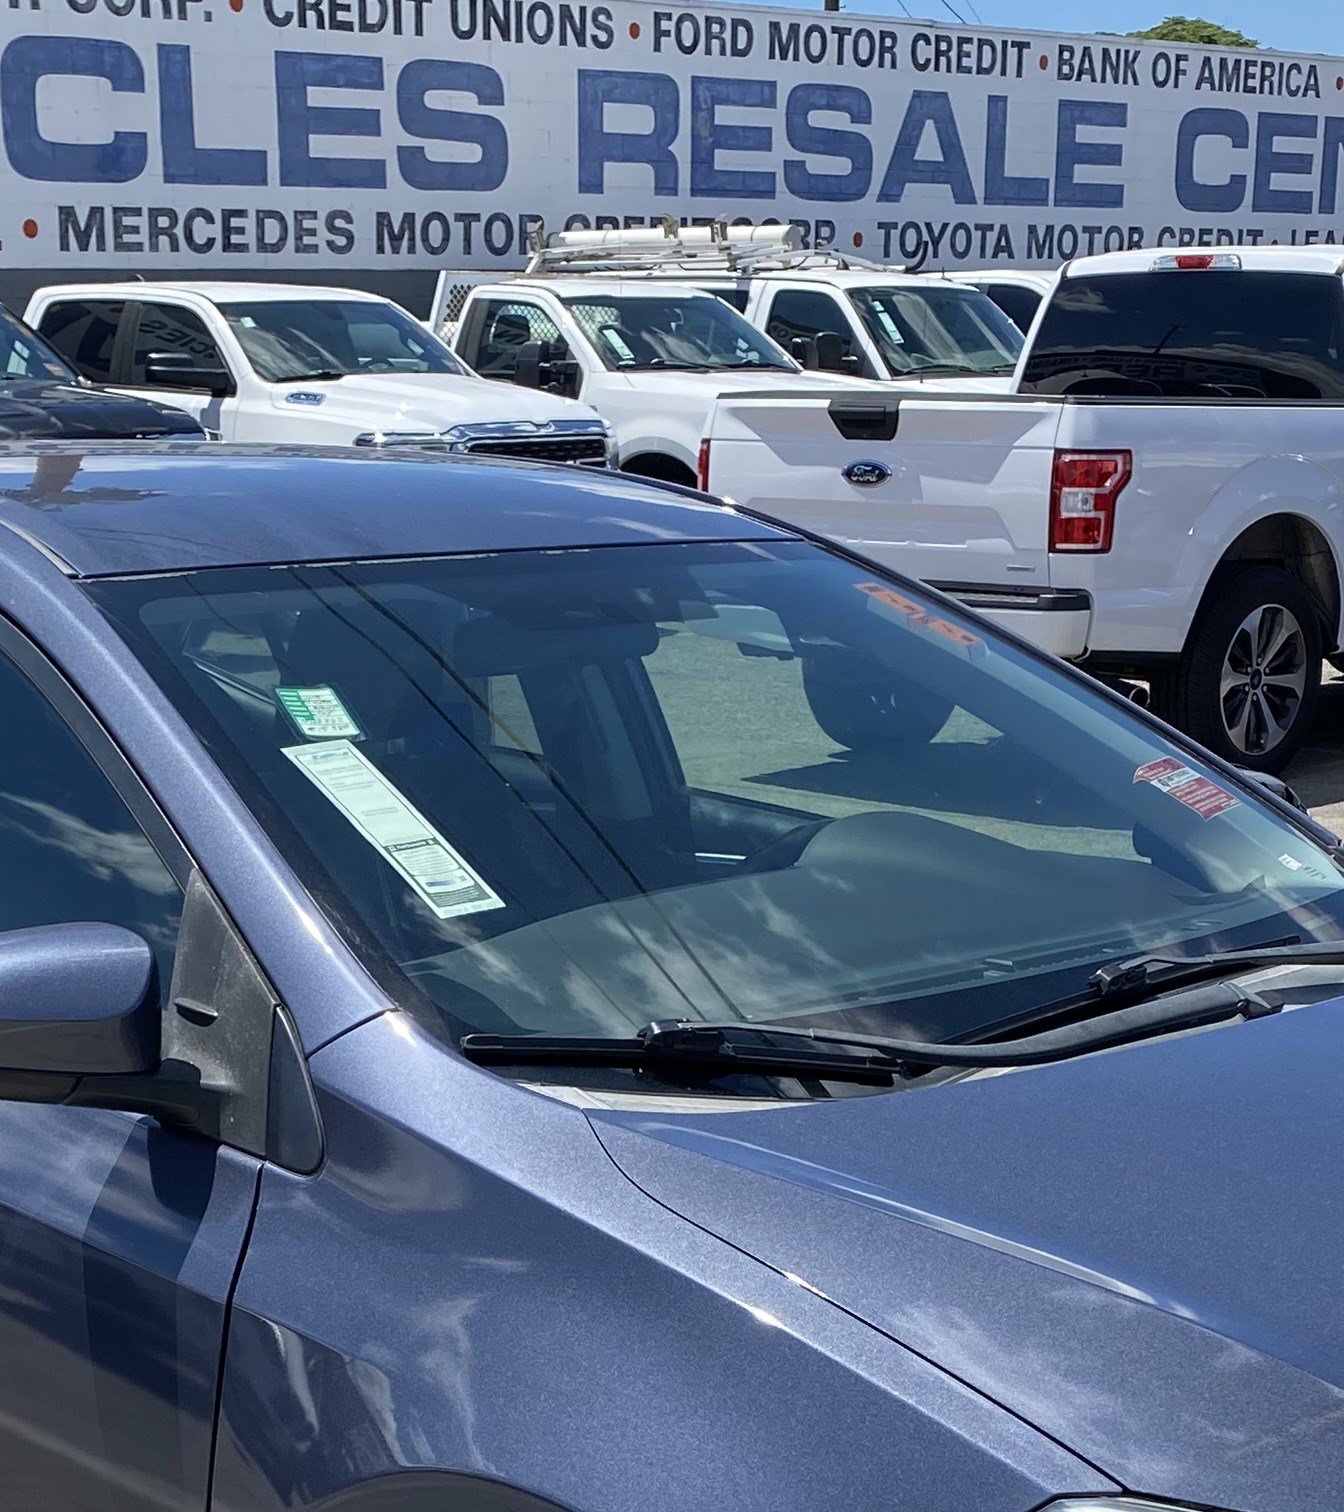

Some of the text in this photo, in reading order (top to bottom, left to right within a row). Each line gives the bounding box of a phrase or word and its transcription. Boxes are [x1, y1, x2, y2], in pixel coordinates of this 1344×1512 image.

[450, 0, 615, 49] UNIONS
[652, 12, 1031, 78] FORD MOTOR CREDIT
[1056, 44, 1321, 100] BANK OF AMERICA
[578, 69, 1128, 208] RESALE
[56, 205, 356, 256] MERCEDES
[375, 210, 544, 256] MOTOR
[876, 221, 1013, 260] TOYOTA
[1027, 224, 1143, 261] MOTOR
